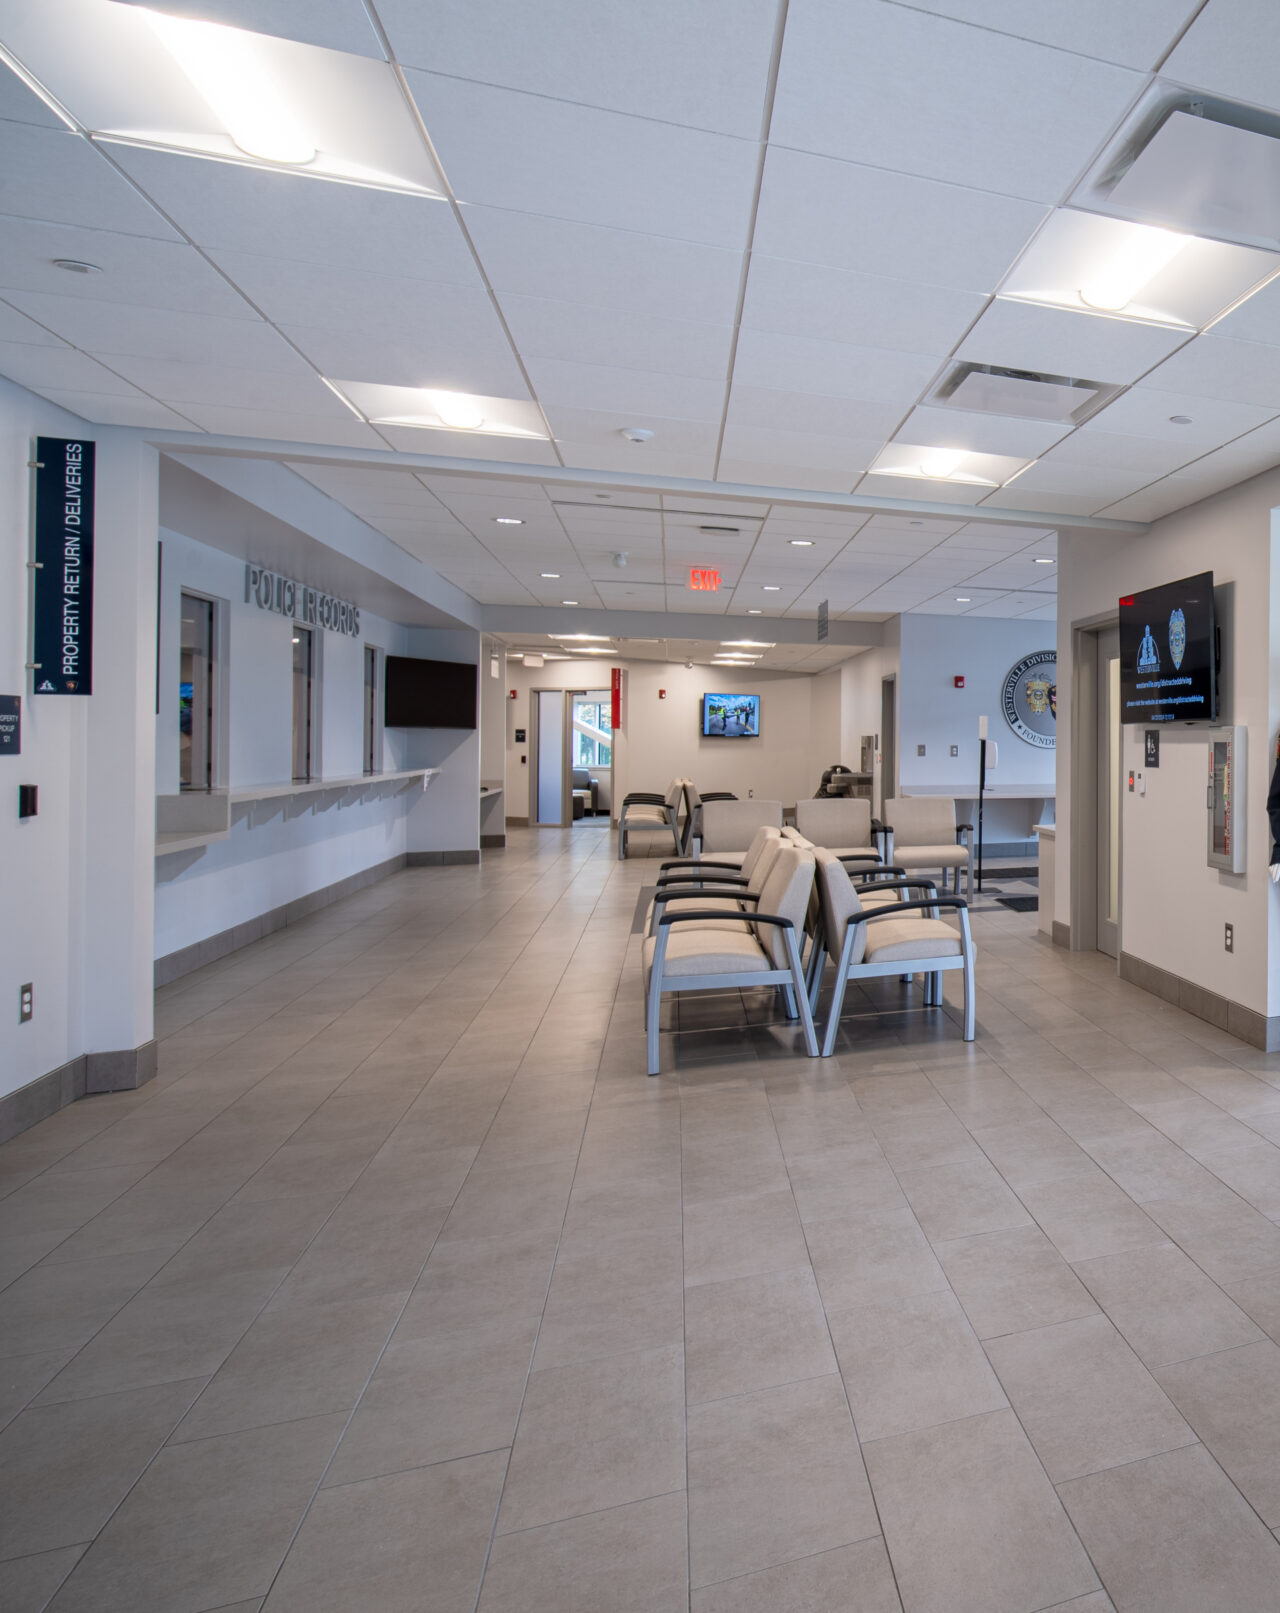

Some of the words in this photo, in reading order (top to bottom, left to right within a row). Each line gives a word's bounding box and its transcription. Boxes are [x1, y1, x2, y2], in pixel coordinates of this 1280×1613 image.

[64, 443, 83, 526] DELIVERIES
[64, 527, 81, 535] /
[63, 536, 81, 595] RETURN
[690, 569, 719, 591] EXIT
[62, 598, 80, 675] PROPERTY
[303, 585, 360, 638] RECORDS
[1006, 663, 1028, 721] WESTERVILLE
[1027, 654, 1056, 668] DIVISIO
[1022, 730, 1056, 746] FOUNDE
